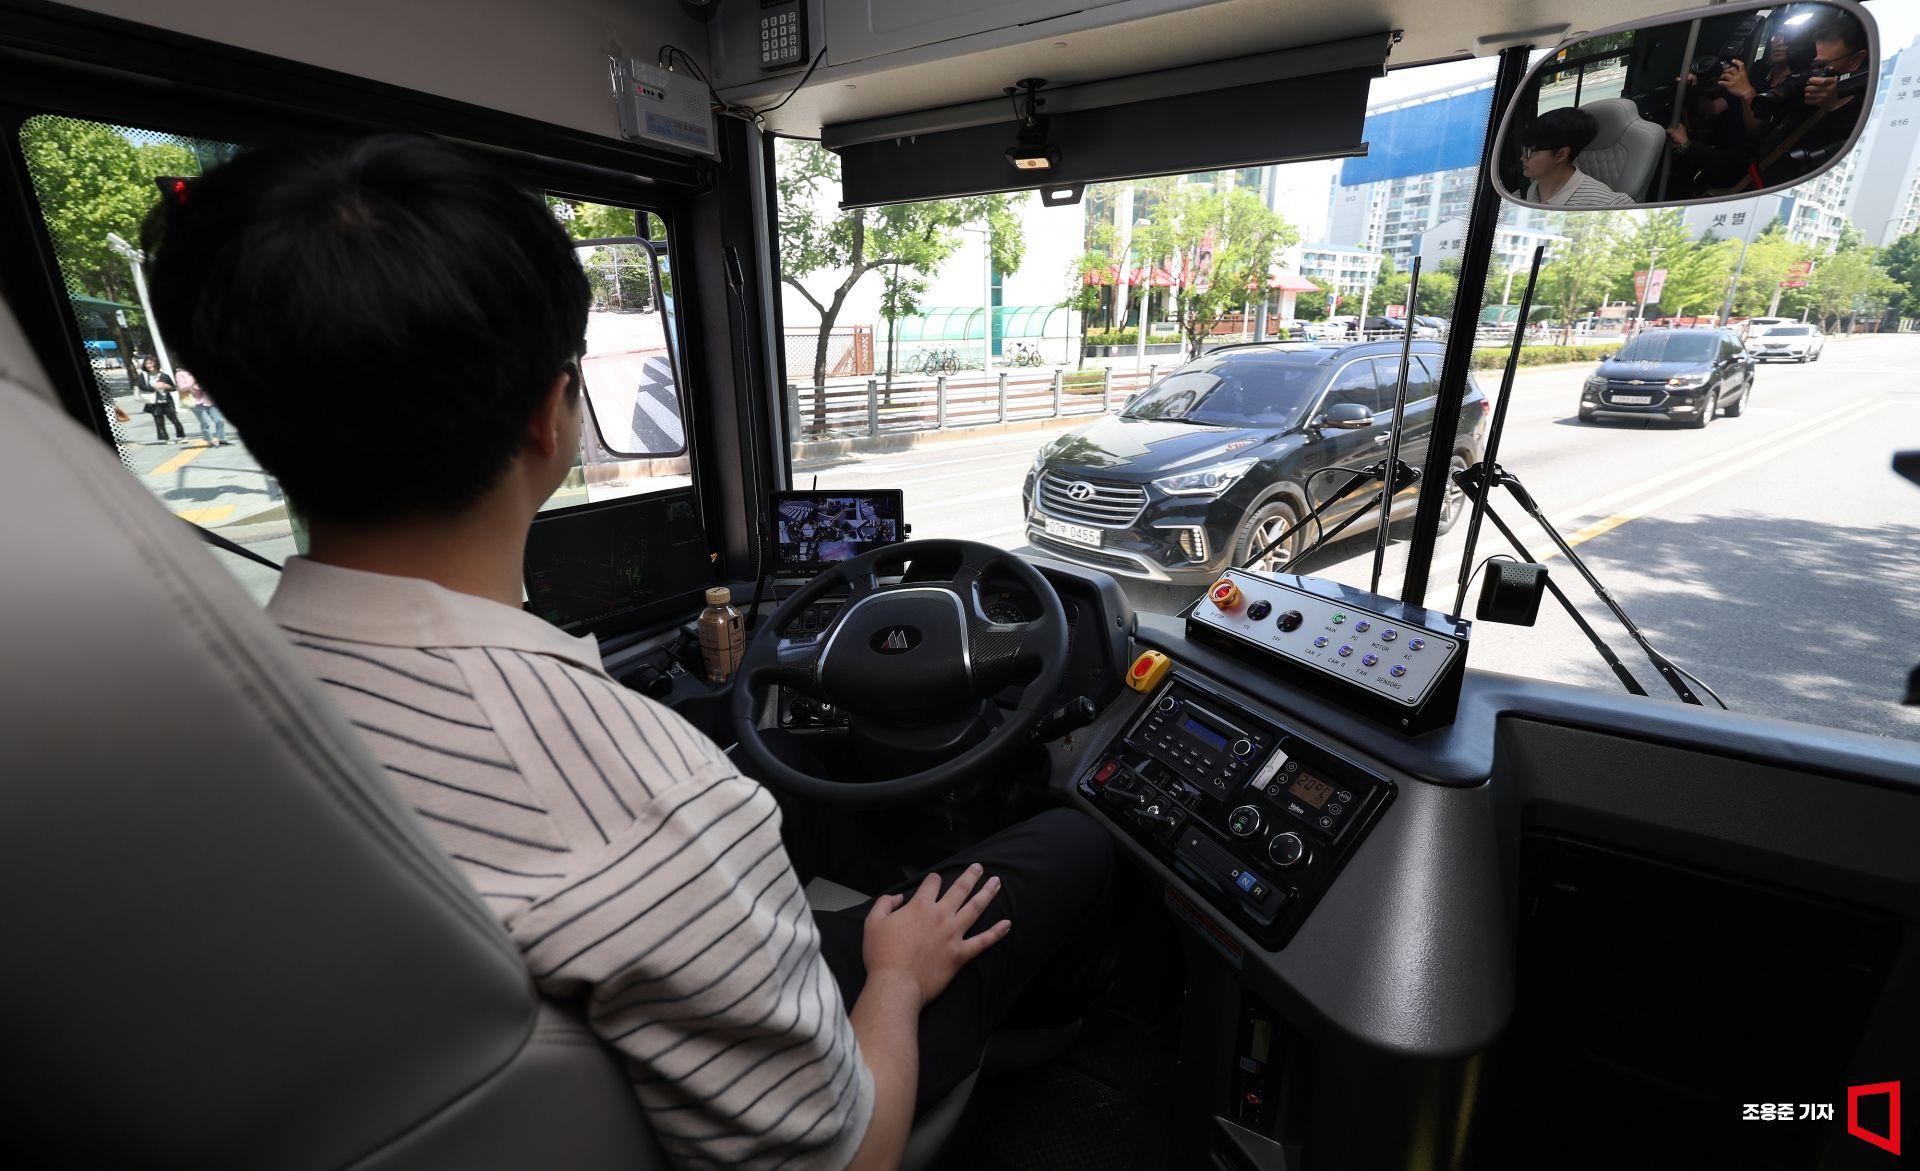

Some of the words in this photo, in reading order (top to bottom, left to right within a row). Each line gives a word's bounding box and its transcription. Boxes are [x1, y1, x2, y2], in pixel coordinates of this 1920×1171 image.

[1070, 526, 1095, 542] 0455
[1371, 642, 1390, 652] MOTOR
[1328, 657, 1339, 665] CAM
[1356, 668, 1368, 676] FAN
[1376, 676, 1402, 690] SENSORS
[1231, 869, 1239, 877] D
[1242, 877, 1250, 887] N
[1253, 886, 1262, 895] R
